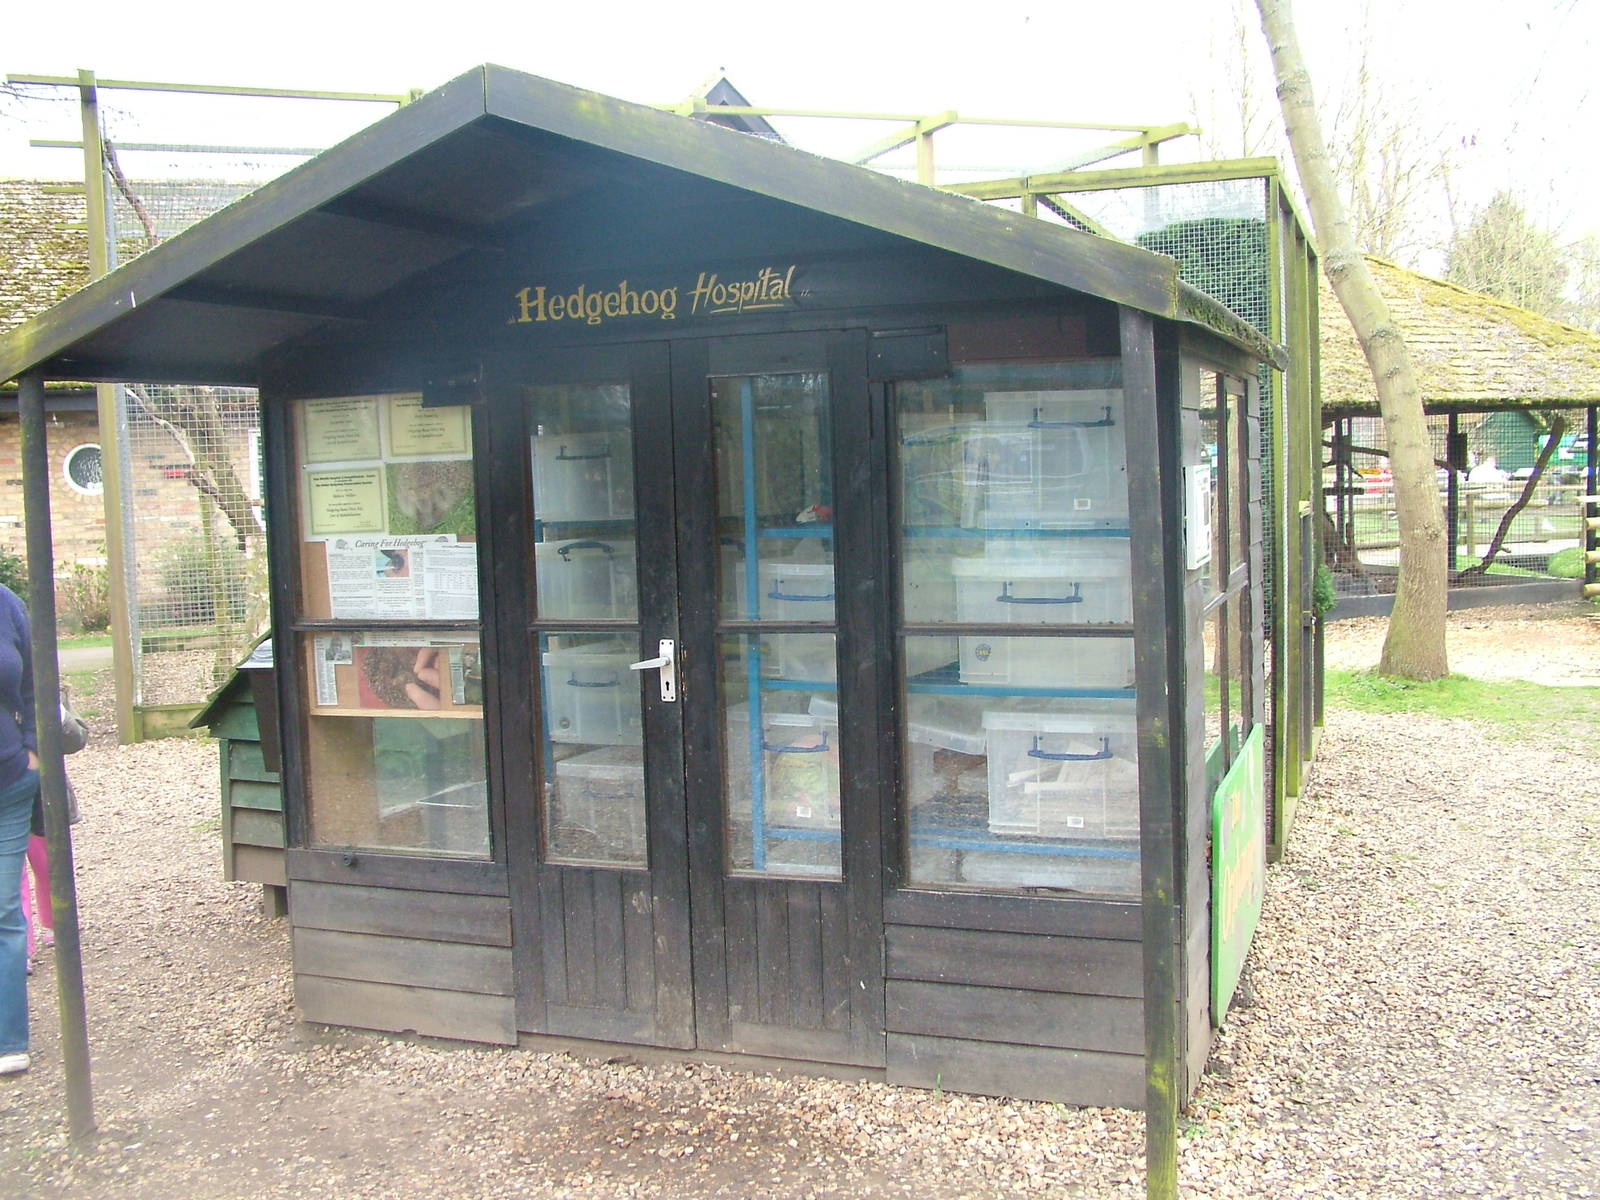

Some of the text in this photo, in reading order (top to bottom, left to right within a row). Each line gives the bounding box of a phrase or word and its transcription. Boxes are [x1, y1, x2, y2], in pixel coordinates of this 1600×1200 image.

[515, 264, 796, 325] Hedgehog Hospital
[355, 540, 379, 550] Caring
[380, 538, 393, 548] For
